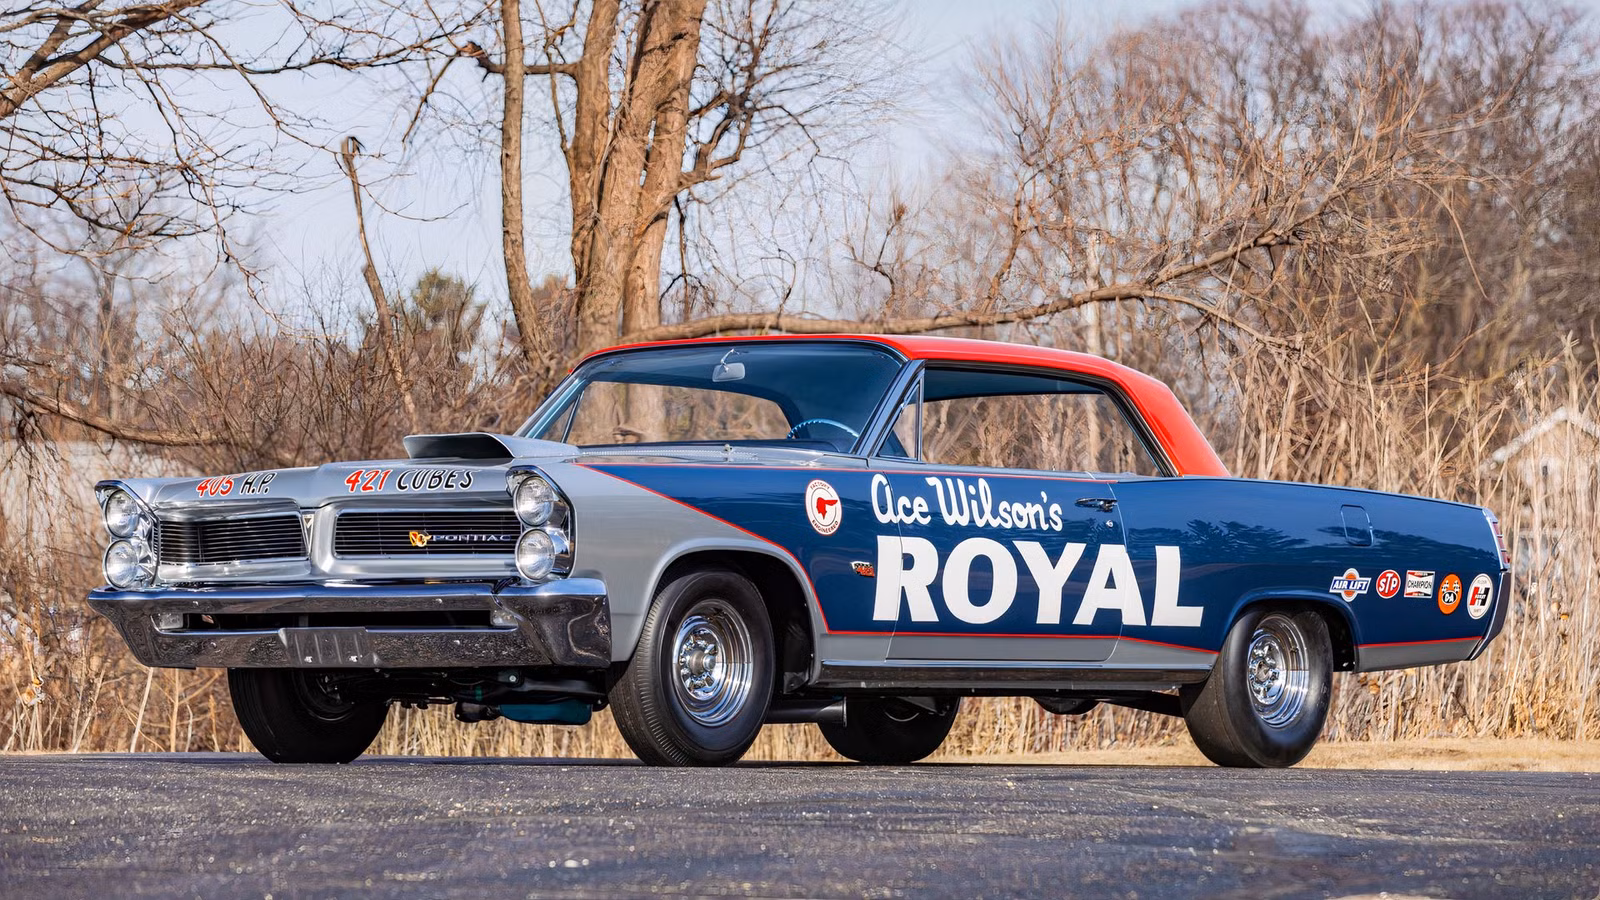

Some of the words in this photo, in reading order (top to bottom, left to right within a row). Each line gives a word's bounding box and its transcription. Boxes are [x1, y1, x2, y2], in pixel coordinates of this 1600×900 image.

[196, 476, 234, 498] 405
[239, 472, 277, 495] H.P.
[344, 469, 393, 493] 421
[396, 469, 481, 491] CUBES
[871, 473, 932, 524] Ace
[925, 476, 1063, 531] Wilson's
[432, 534, 513, 543] PONTIAC
[872, 535, 1204, 627] ROYAL
[1332, 580, 1349, 590] AIR
[1349, 580, 1369, 591] LIFT
[1379, 573, 1399, 594] STP
[1407, 580, 1432, 589] CHAMPION
